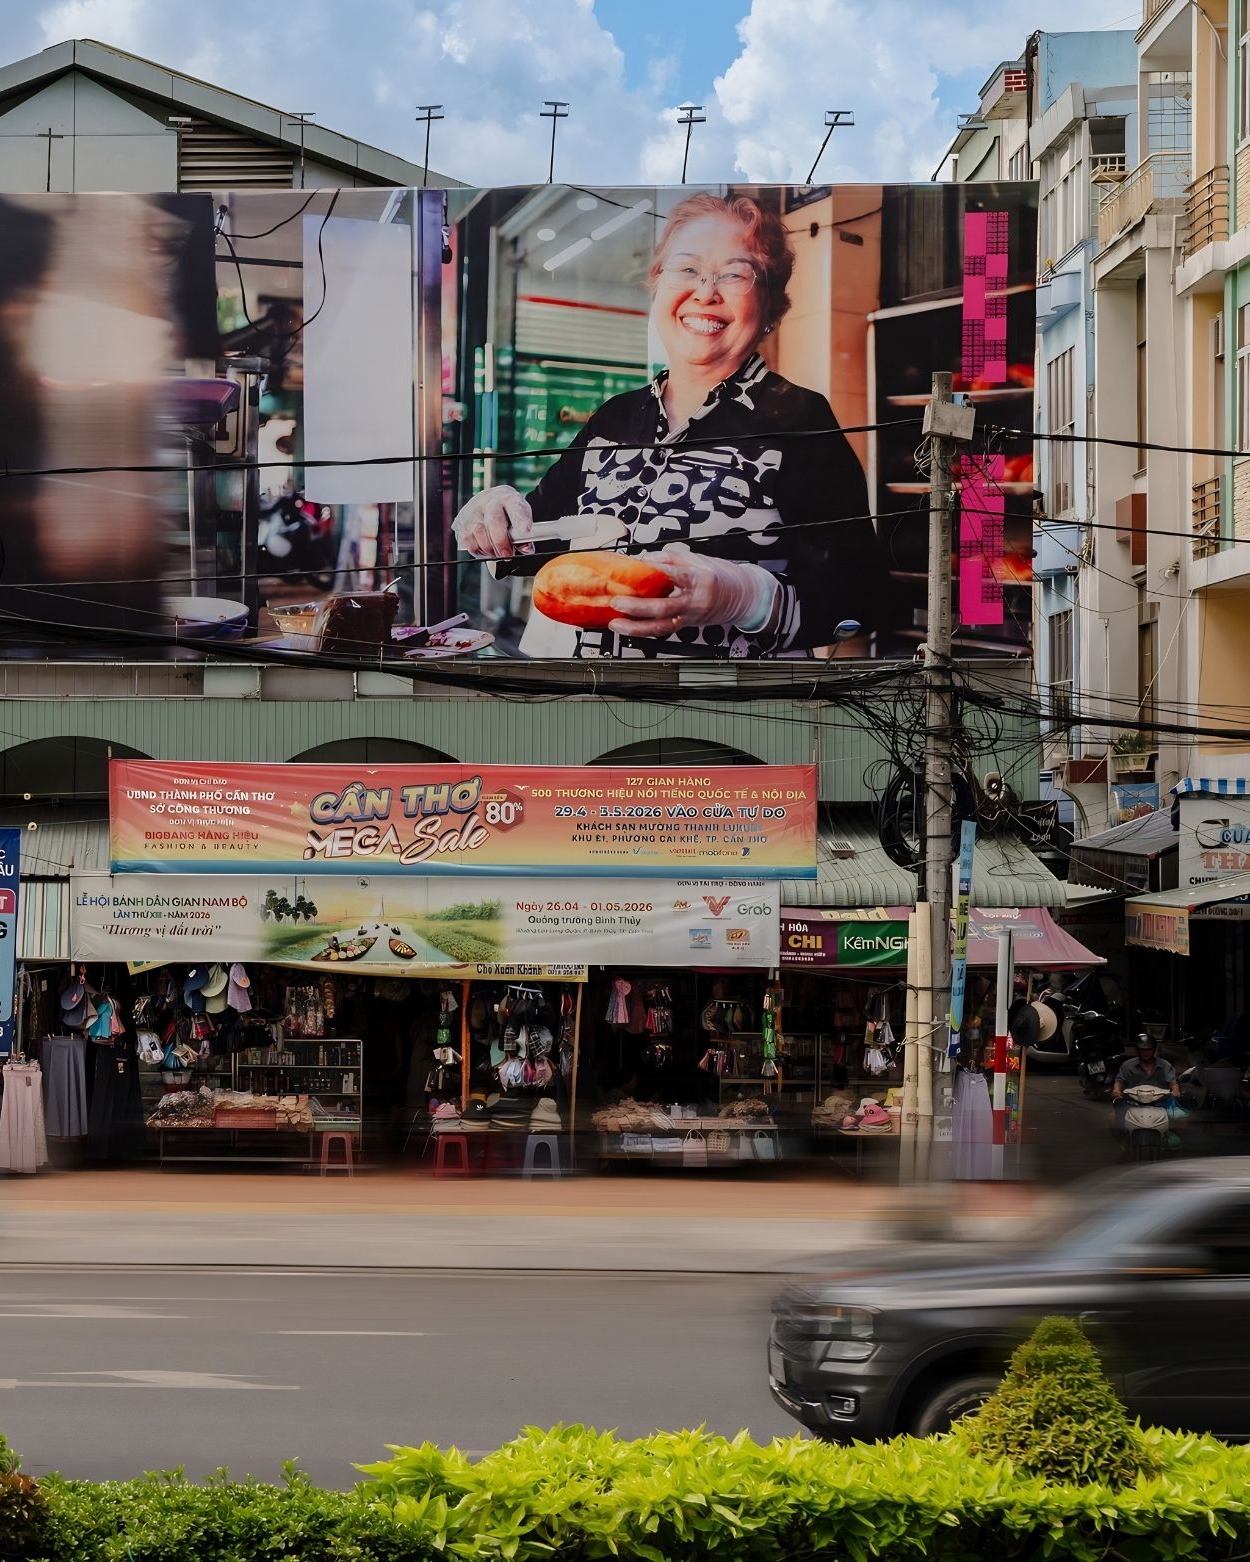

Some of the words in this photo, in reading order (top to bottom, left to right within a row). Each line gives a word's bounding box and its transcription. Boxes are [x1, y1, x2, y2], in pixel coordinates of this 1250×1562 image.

[626, 777, 643, 786] 127
[646, 777, 674, 786] GIAN
[678, 775, 711, 786] HÀNG
[127, 790, 157, 799] UBND
[159, 788, 197, 800] THÀNH
[200, 788, 223, 800] PHỐ
[251, 791, 275, 801] THƠ
[401, 775, 483, 818] THƠ
[531, 789, 552, 797] 500
[555, 788, 603, 798] THƯƠNG
[607, 788, 633, 799] HIỆU
[661, 787, 694, 798] TIẾNG
[697, 787, 730, 799] QUỐC
[751, 790, 758, 798] &
[762, 788, 782, 800] NỘI
[150, 803, 166, 813] SỞ
[167, 803, 200, 814] CÔNG
[203, 804, 251, 815] THƯƠNG
[554, 805, 587, 818] 29.4
[599, 805, 662, 818] 3.5.2026
[666, 803, 698, 818] VÀO
[702, 803, 735, 818] CỬA
[737, 804, 759, 821] TỰ
[762, 806, 787, 819] DO
[576, 821, 612, 831] KHÁCH
[616, 822, 636, 834] SẠN
[303, 824, 400, 860] MEGA
[399, 812, 490, 865] Sale
[572, 834, 592, 842] KHU
[76, 892, 88, 906] LỄ
[90, 895, 110, 908] HỘI
[113, 894, 144, 907] BÁNH
[172, 897, 200, 907] GIAN
[202, 897, 230, 907] NAM
[231, 895, 248, 909] BỘ
[516, 901, 544, 912] Ngày
[546, 901, 579, 911] 26.04
[590, 902, 653, 912] 01.05.2026
[113, 909, 130, 919] LẦN
[132, 910, 150, 919] THỨ
[189, 911, 211, 919] 2026
[737, 902, 772, 915] Grab
[528, 915, 560, 926] Quảng
[562, 915, 593, 926] trường
[595, 915, 616, 925] Bình
[618, 915, 642, 927] Thủy
[788, 922, 808, 932] HÓA
[156, 925, 166, 938] vị
[169, 921, 188, 936] đất
[788, 934, 823, 949] CHI
